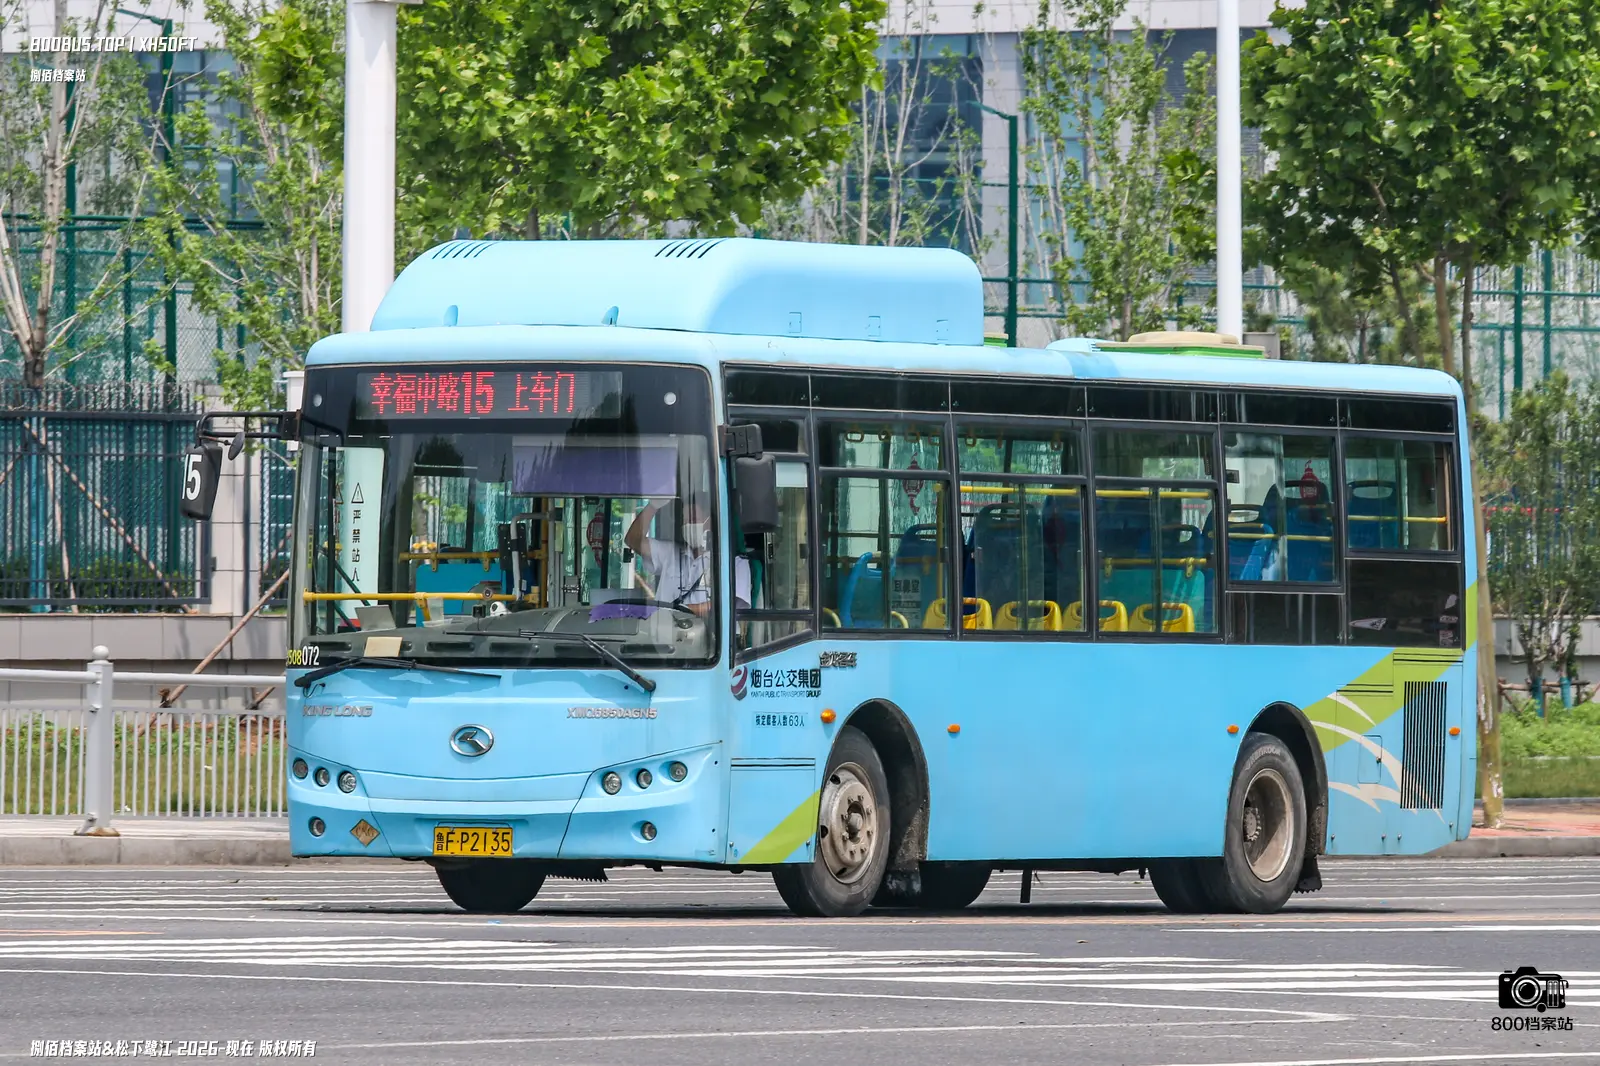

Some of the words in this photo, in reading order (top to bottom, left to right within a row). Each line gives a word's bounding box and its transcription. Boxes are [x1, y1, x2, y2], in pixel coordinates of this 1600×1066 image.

[508, 371, 575, 413] 上车门
[751, 669, 821, 688] 烟台公交集团
[303, 705, 332, 717] KING
[334, 705, 373, 717] LONG
